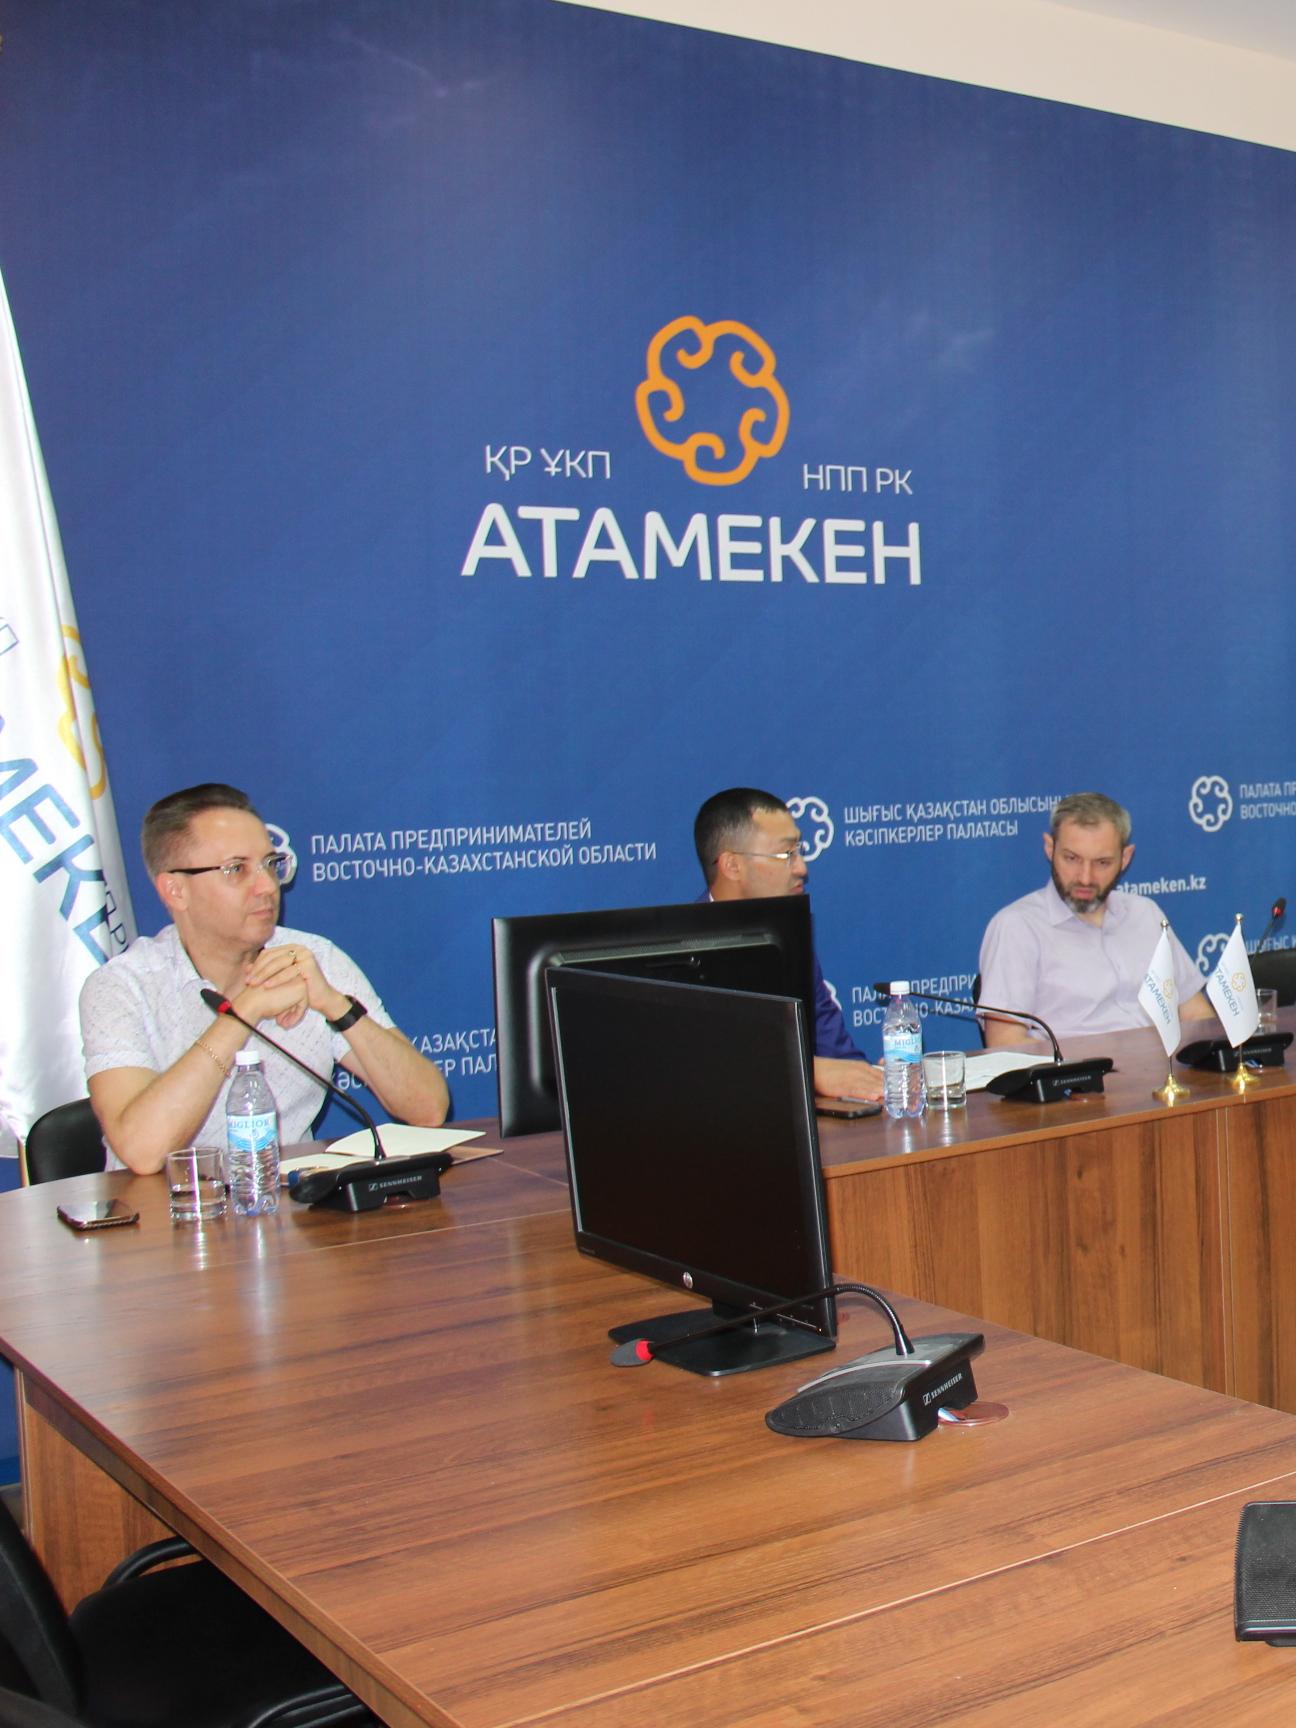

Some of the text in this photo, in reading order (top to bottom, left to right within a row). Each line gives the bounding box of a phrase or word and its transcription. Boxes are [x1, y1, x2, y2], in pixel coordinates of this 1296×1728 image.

[485, 445, 611, 481] ҚР ҰКП
[803, 464, 913, 495] НПП РК
[461, 503, 921, 586] АТАМЕКЕН
[1240, 782, 1282, 799] ПАЛАТА
[844, 804, 902, 824] ШЫҒЫС
[906, 799, 987, 823] ҚАЗАҚСТАН
[311, 817, 592, 855] ПАЛАТА ПРЕДПРИНИМАТЕЛЕЙ
[845, 820, 1018, 847] КӘСІПКЕРЛЕР ПАЛАТАСЫ
[313, 842, 657, 882] ВОСТОЧНО-КАЗАХСТАНСКОЙ ОБЛАСТИ
[379, 1176, 423, 1189] SENNHEISER
[931, 1372, 963, 1399] SENNHEISER
